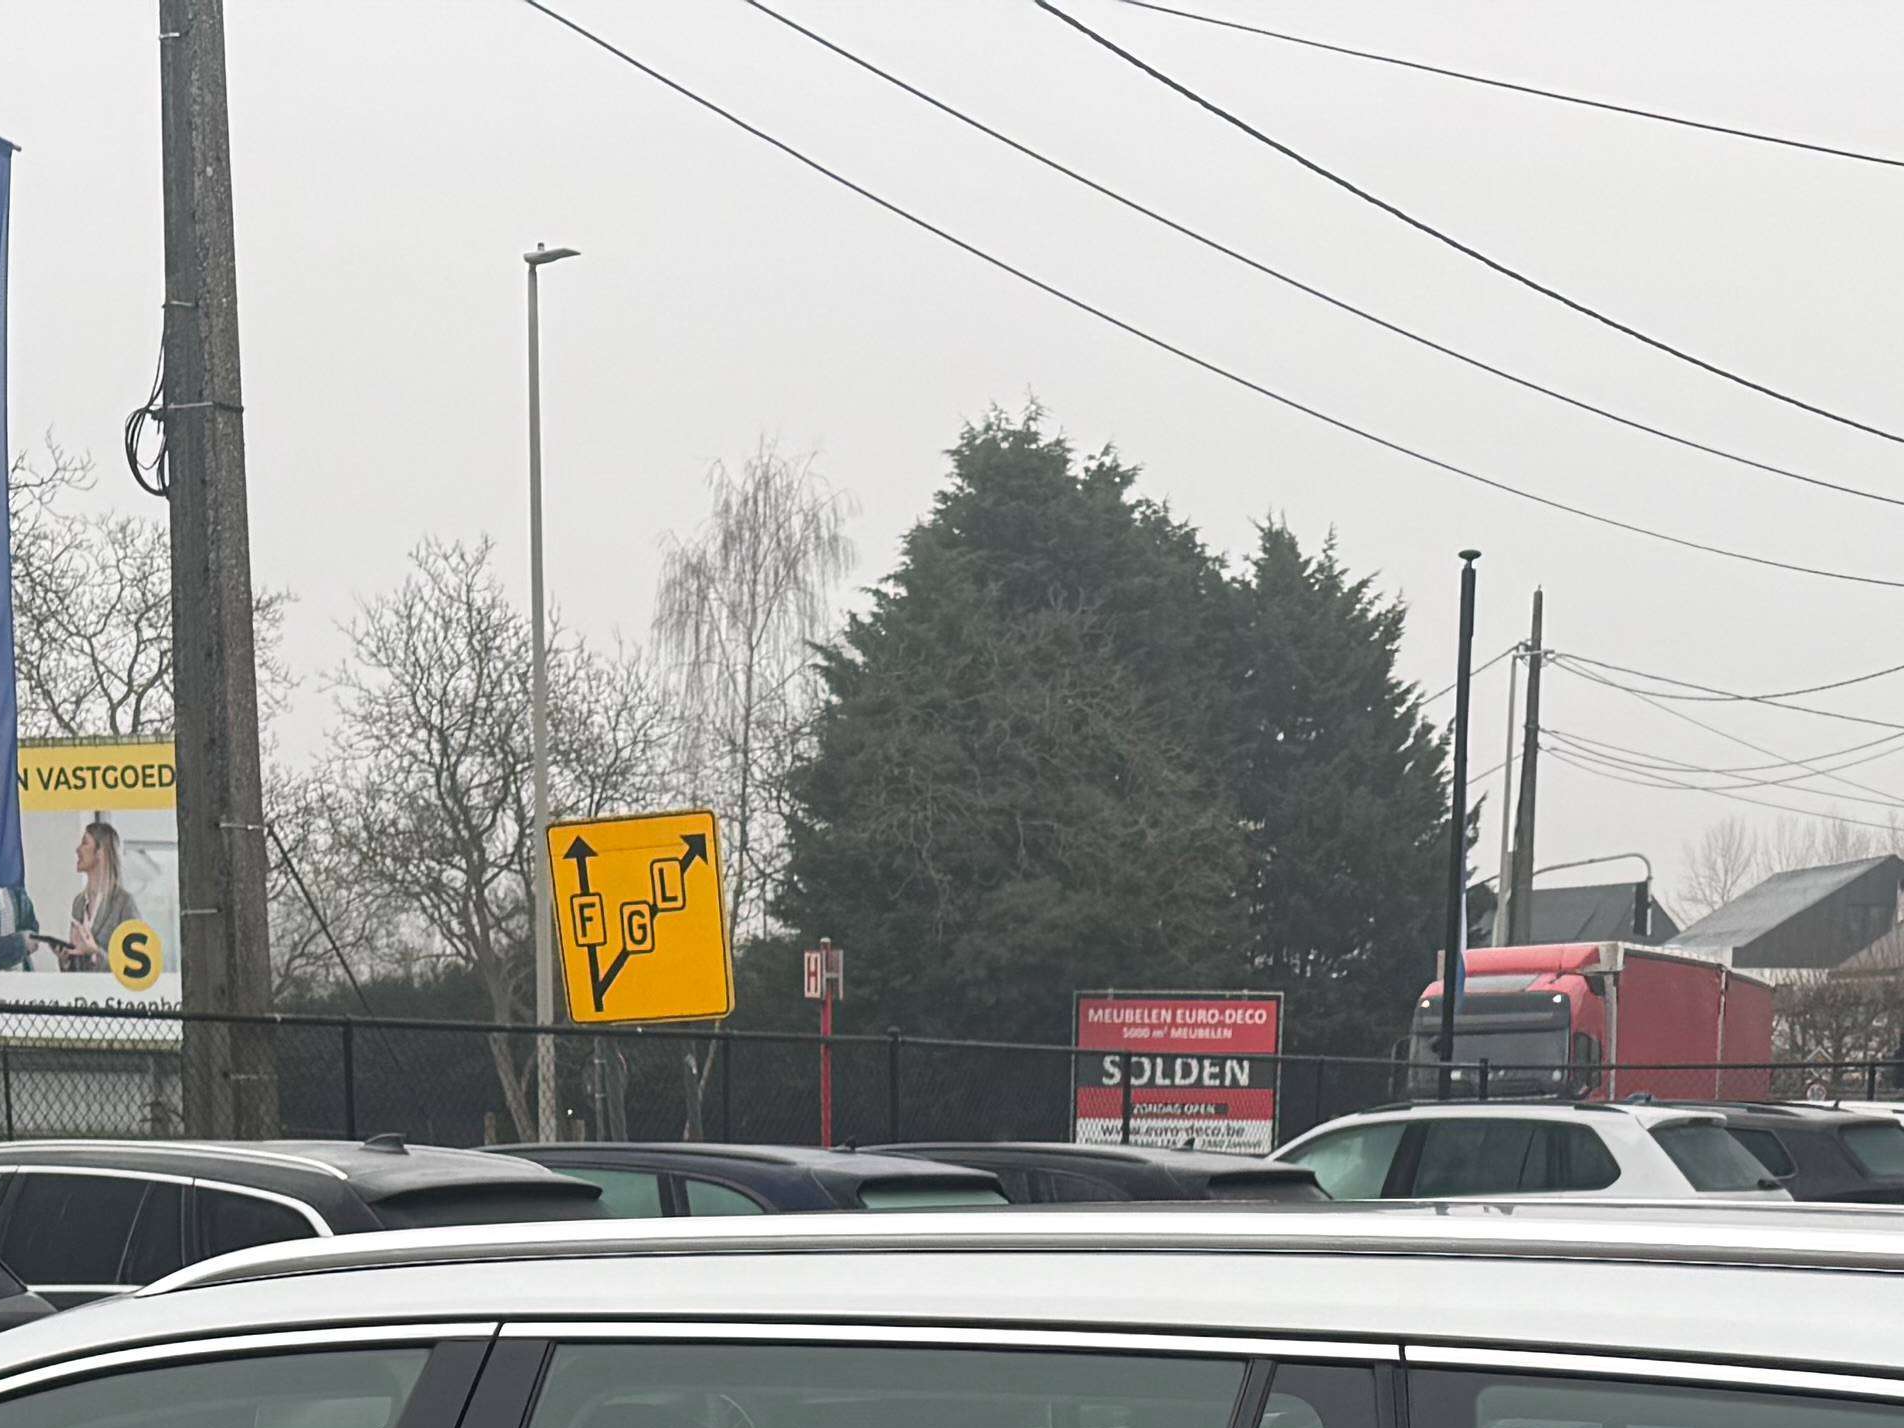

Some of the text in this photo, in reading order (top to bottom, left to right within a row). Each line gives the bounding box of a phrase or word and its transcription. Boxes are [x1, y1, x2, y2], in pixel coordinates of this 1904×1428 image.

[36, 763, 175, 791] VASTGOED
[657, 866, 678, 903] L
[578, 902, 596, 938] F
[627, 909, 647, 945] G
[120, 932, 152, 980] S
[1088, 1007, 1267, 1025] MEUBELEN EURO-DECO
[1170, 1027, 1233, 1039] MEUBELEN
[1102, 1054, 1250, 1088] SOLDEN
